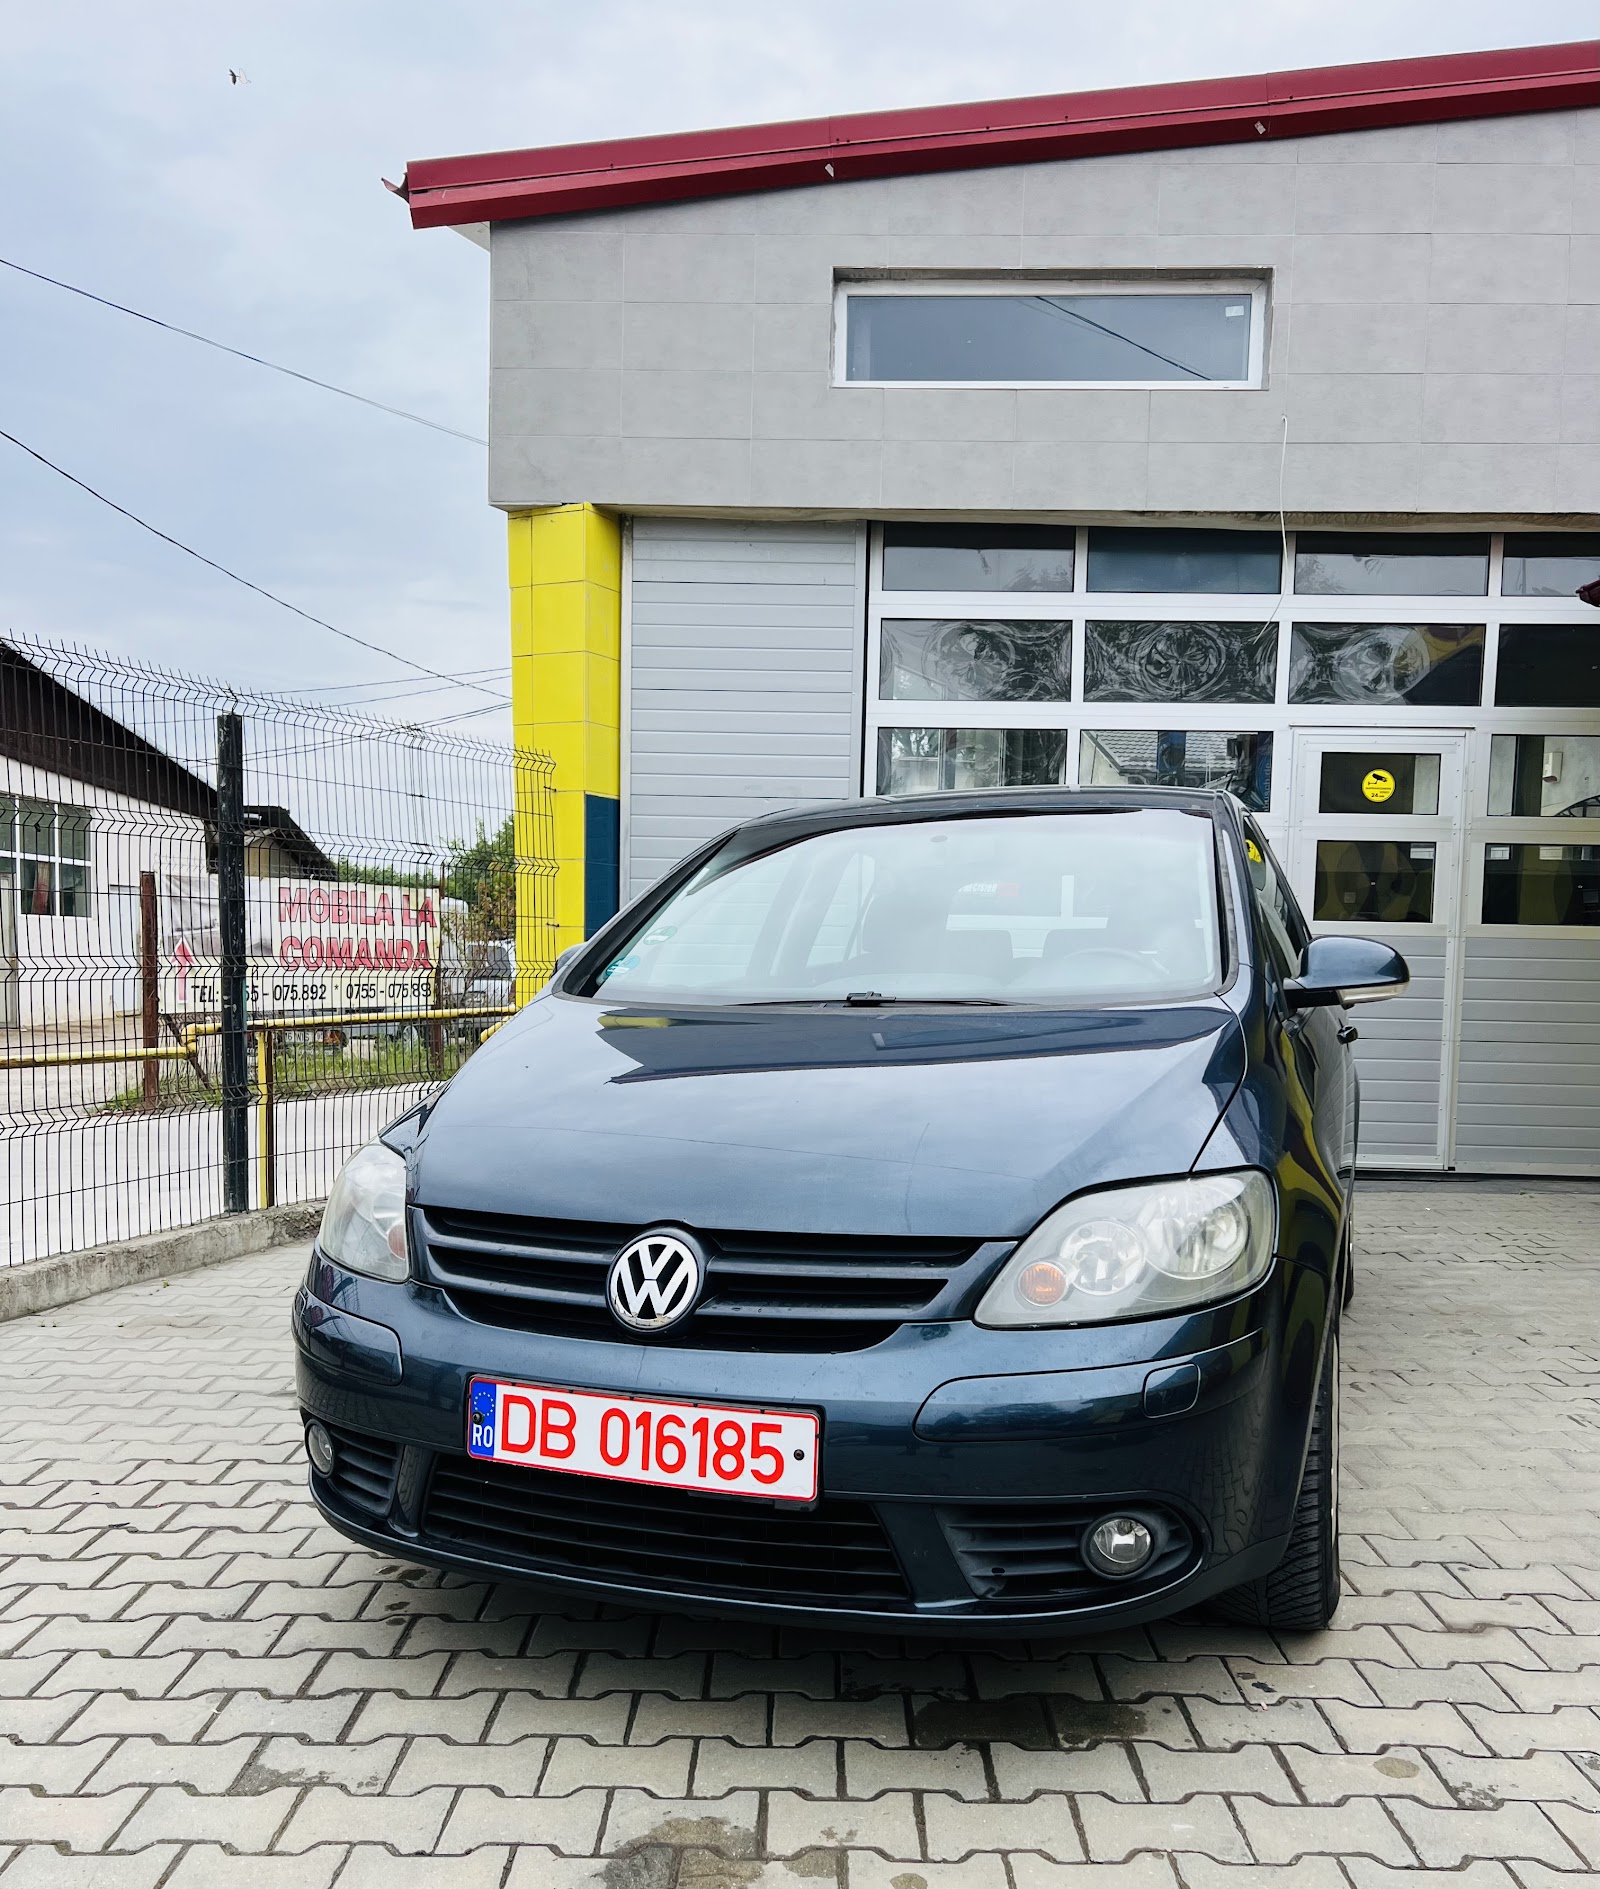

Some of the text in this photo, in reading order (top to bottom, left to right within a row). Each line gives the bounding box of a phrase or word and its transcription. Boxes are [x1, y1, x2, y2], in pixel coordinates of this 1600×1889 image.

[279, 886, 437, 928] MOBILA LA
[280, 935, 433, 971] COMANDA
[346, 983, 376, 999] 0755
[612, 1238, 696, 1325] VW
[472, 1424, 493, 1448] RO
[500, 1393, 785, 1484] DB 016185
